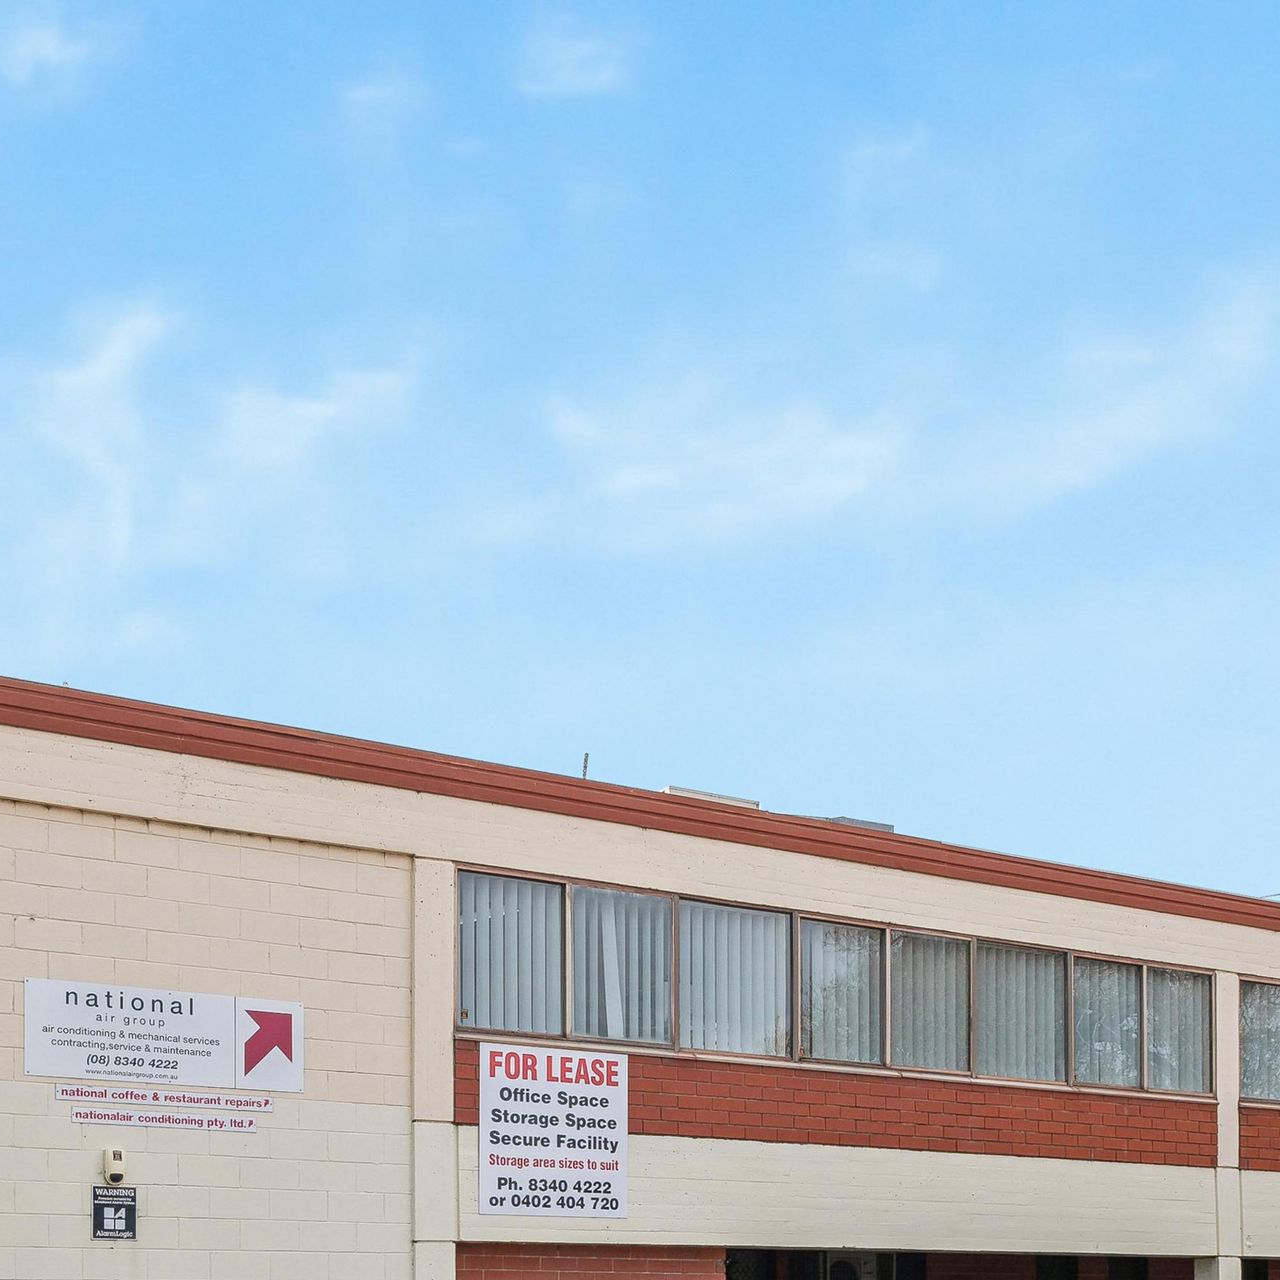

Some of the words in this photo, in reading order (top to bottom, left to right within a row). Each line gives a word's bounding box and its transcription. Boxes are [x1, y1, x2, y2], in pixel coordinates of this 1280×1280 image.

[65, 991, 195, 1016] national
[96, 1013, 115, 1022] air
[123, 1016, 166, 1029] group
[42, 1025, 54, 1033] air
[57, 1026, 116, 1040] conditioning
[128, 1031, 181, 1043] mechanical
[183, 1036, 220, 1046] services
[51, 1037, 142, 1052] contracting,service
[154, 1044, 212, 1057] maintenance
[86, 1054, 110, 1067] (08)
[114, 1056, 145, 1068] 8340
[148, 1059, 178, 1070] 4222
[489, 1051, 537, 1081] FOR
[546, 1055, 619, 1087] LEASE
[85, 1068, 178, 1080] www.nationalairgroup.com.au
[61, 1087, 107, 1098] national
[111, 1090, 147, 1101] coffee
[152, 1093, 160, 1101] &
[164, 1093, 221, 1105] restaurant
[225, 1096, 262, 1108] repairs
[500, 1087, 551, 1101] Office
[557, 1091, 609, 1108] Space
[75, 1109, 134, 1122] nationalair
[138, 1114, 204, 1127] conditioning
[207, 1118, 226, 1128] pty.
[230, 1118, 246, 1128] ltd.
[491, 1109, 559, 1128] Storage
[565, 1113, 617, 1130] Space
[489, 1130, 550, 1148] Secure
[557, 1134, 618, 1153] Facility
[489, 1154, 529, 1169] Storage
[533, 1158, 555, 1168] area
[558, 1158, 584, 1169] sizes
[587, 1159, 597, 1170] to
[600, 1160, 619, 1171] suit
[95, 1188, 135, 1196] WARNING
[497, 1177, 522, 1191] Ph.
[528, 1179, 567, 1192] 8340
[573, 1181, 612, 1194] 4222
[489, 1196, 506, 1207] or
[511, 1194, 551, 1208] 0402
[556, 1196, 585, 1209] 404
[591, 1197, 618, 1210] 720
